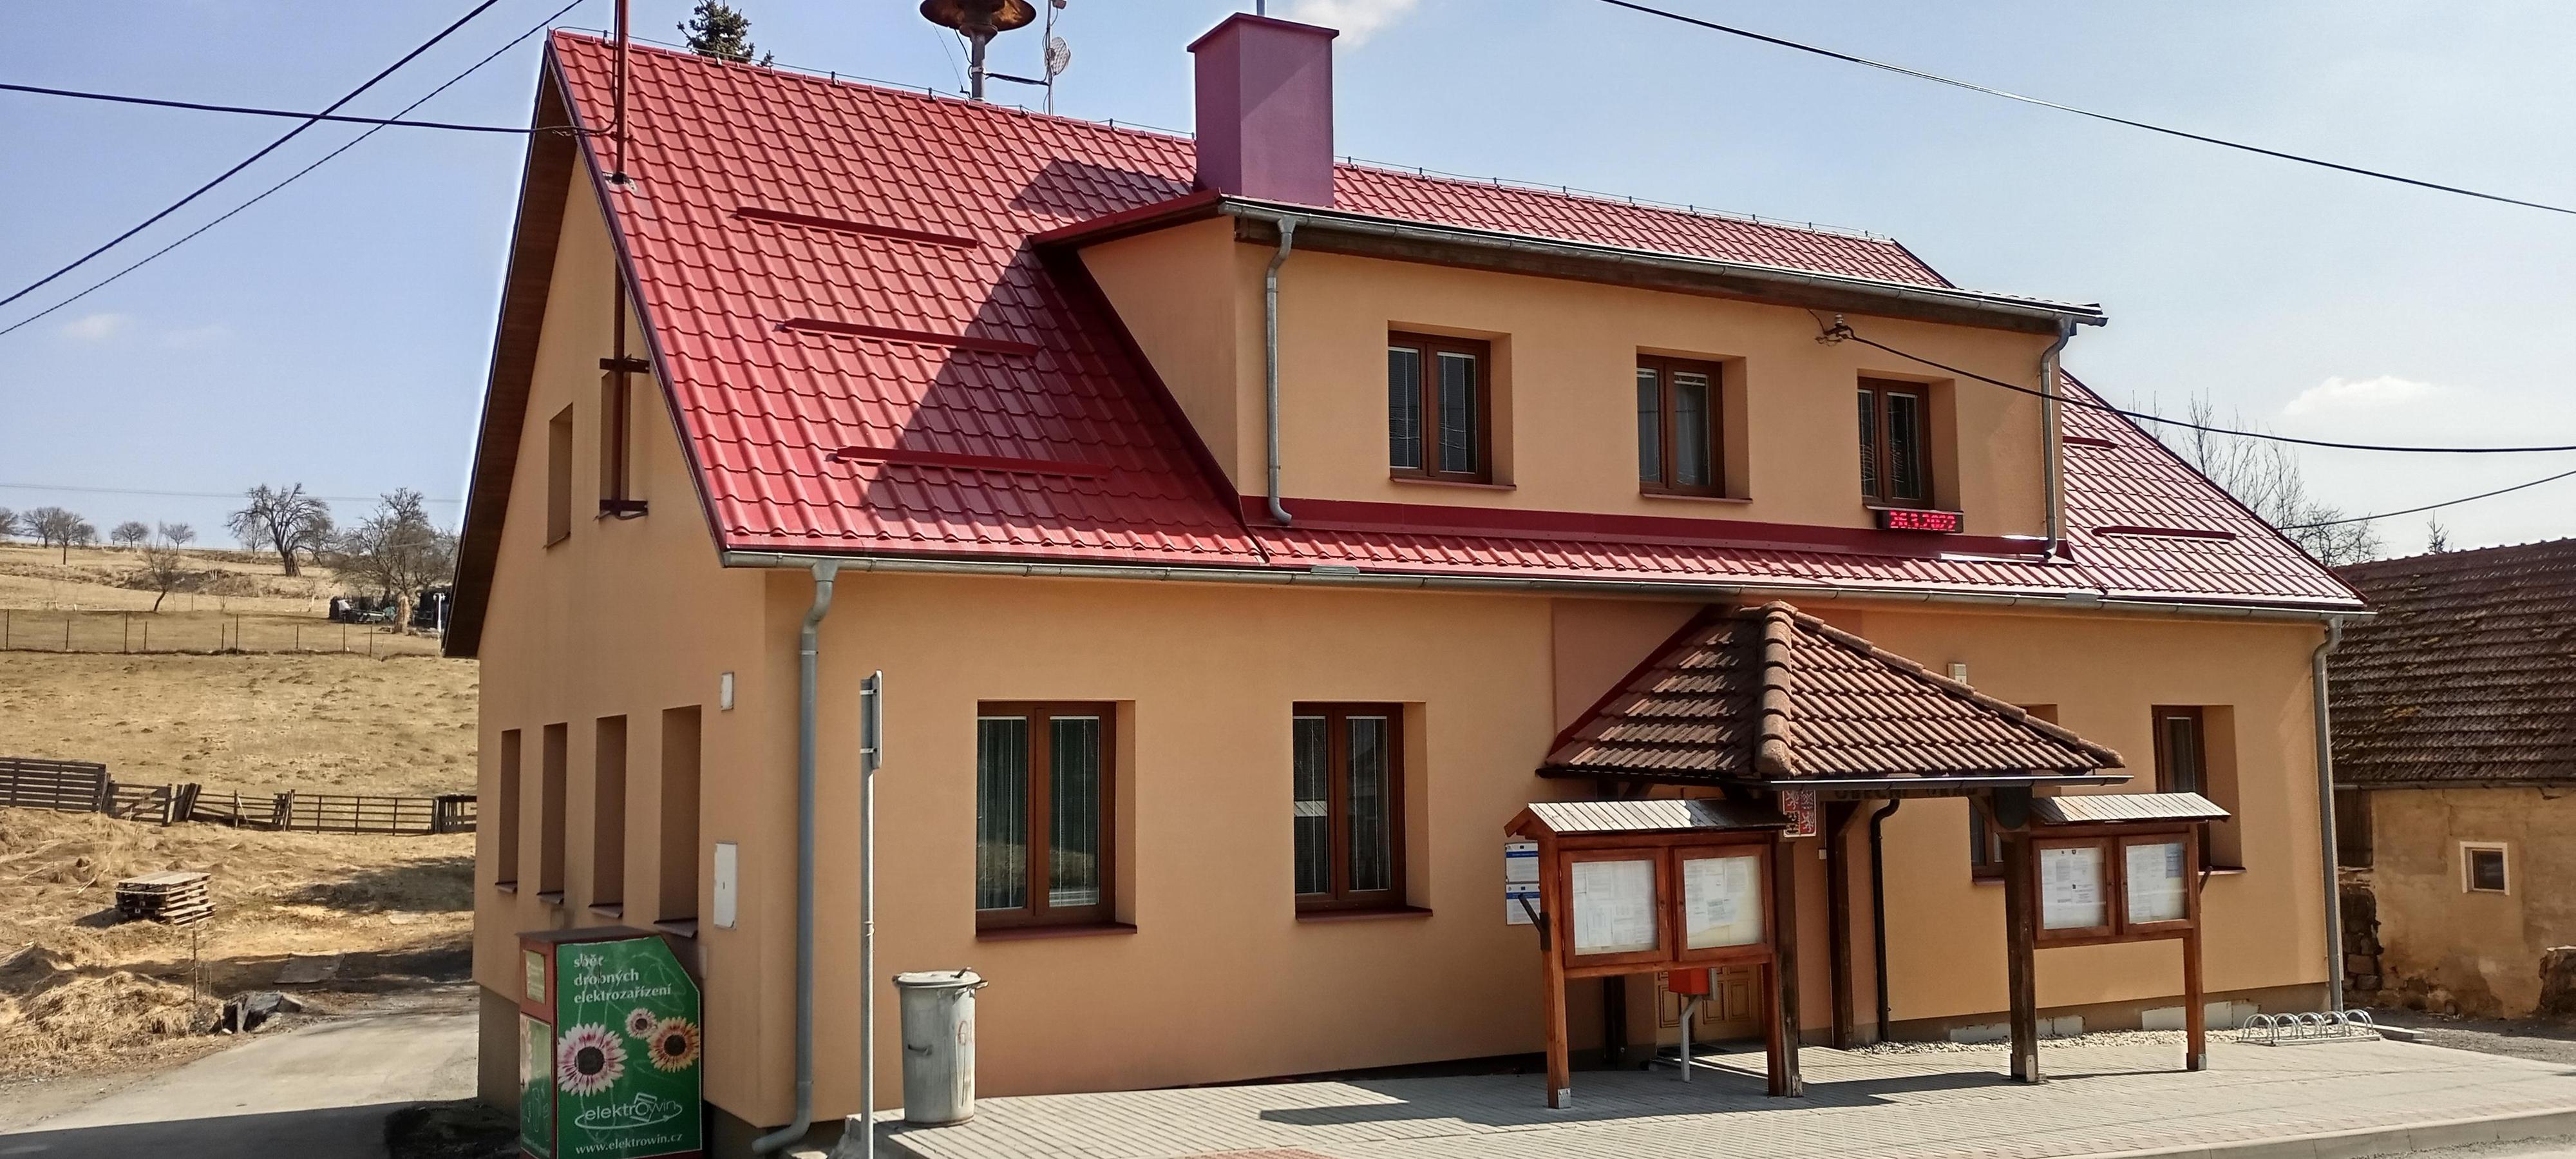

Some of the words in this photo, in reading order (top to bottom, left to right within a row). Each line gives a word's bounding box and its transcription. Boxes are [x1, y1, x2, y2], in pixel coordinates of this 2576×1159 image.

[1890, 511, 1956, 532] 26.3.2022
[573, 982, 672, 1004] elektrozařízení
[575, 1133, 683, 1154] www.elektrowin.cz
